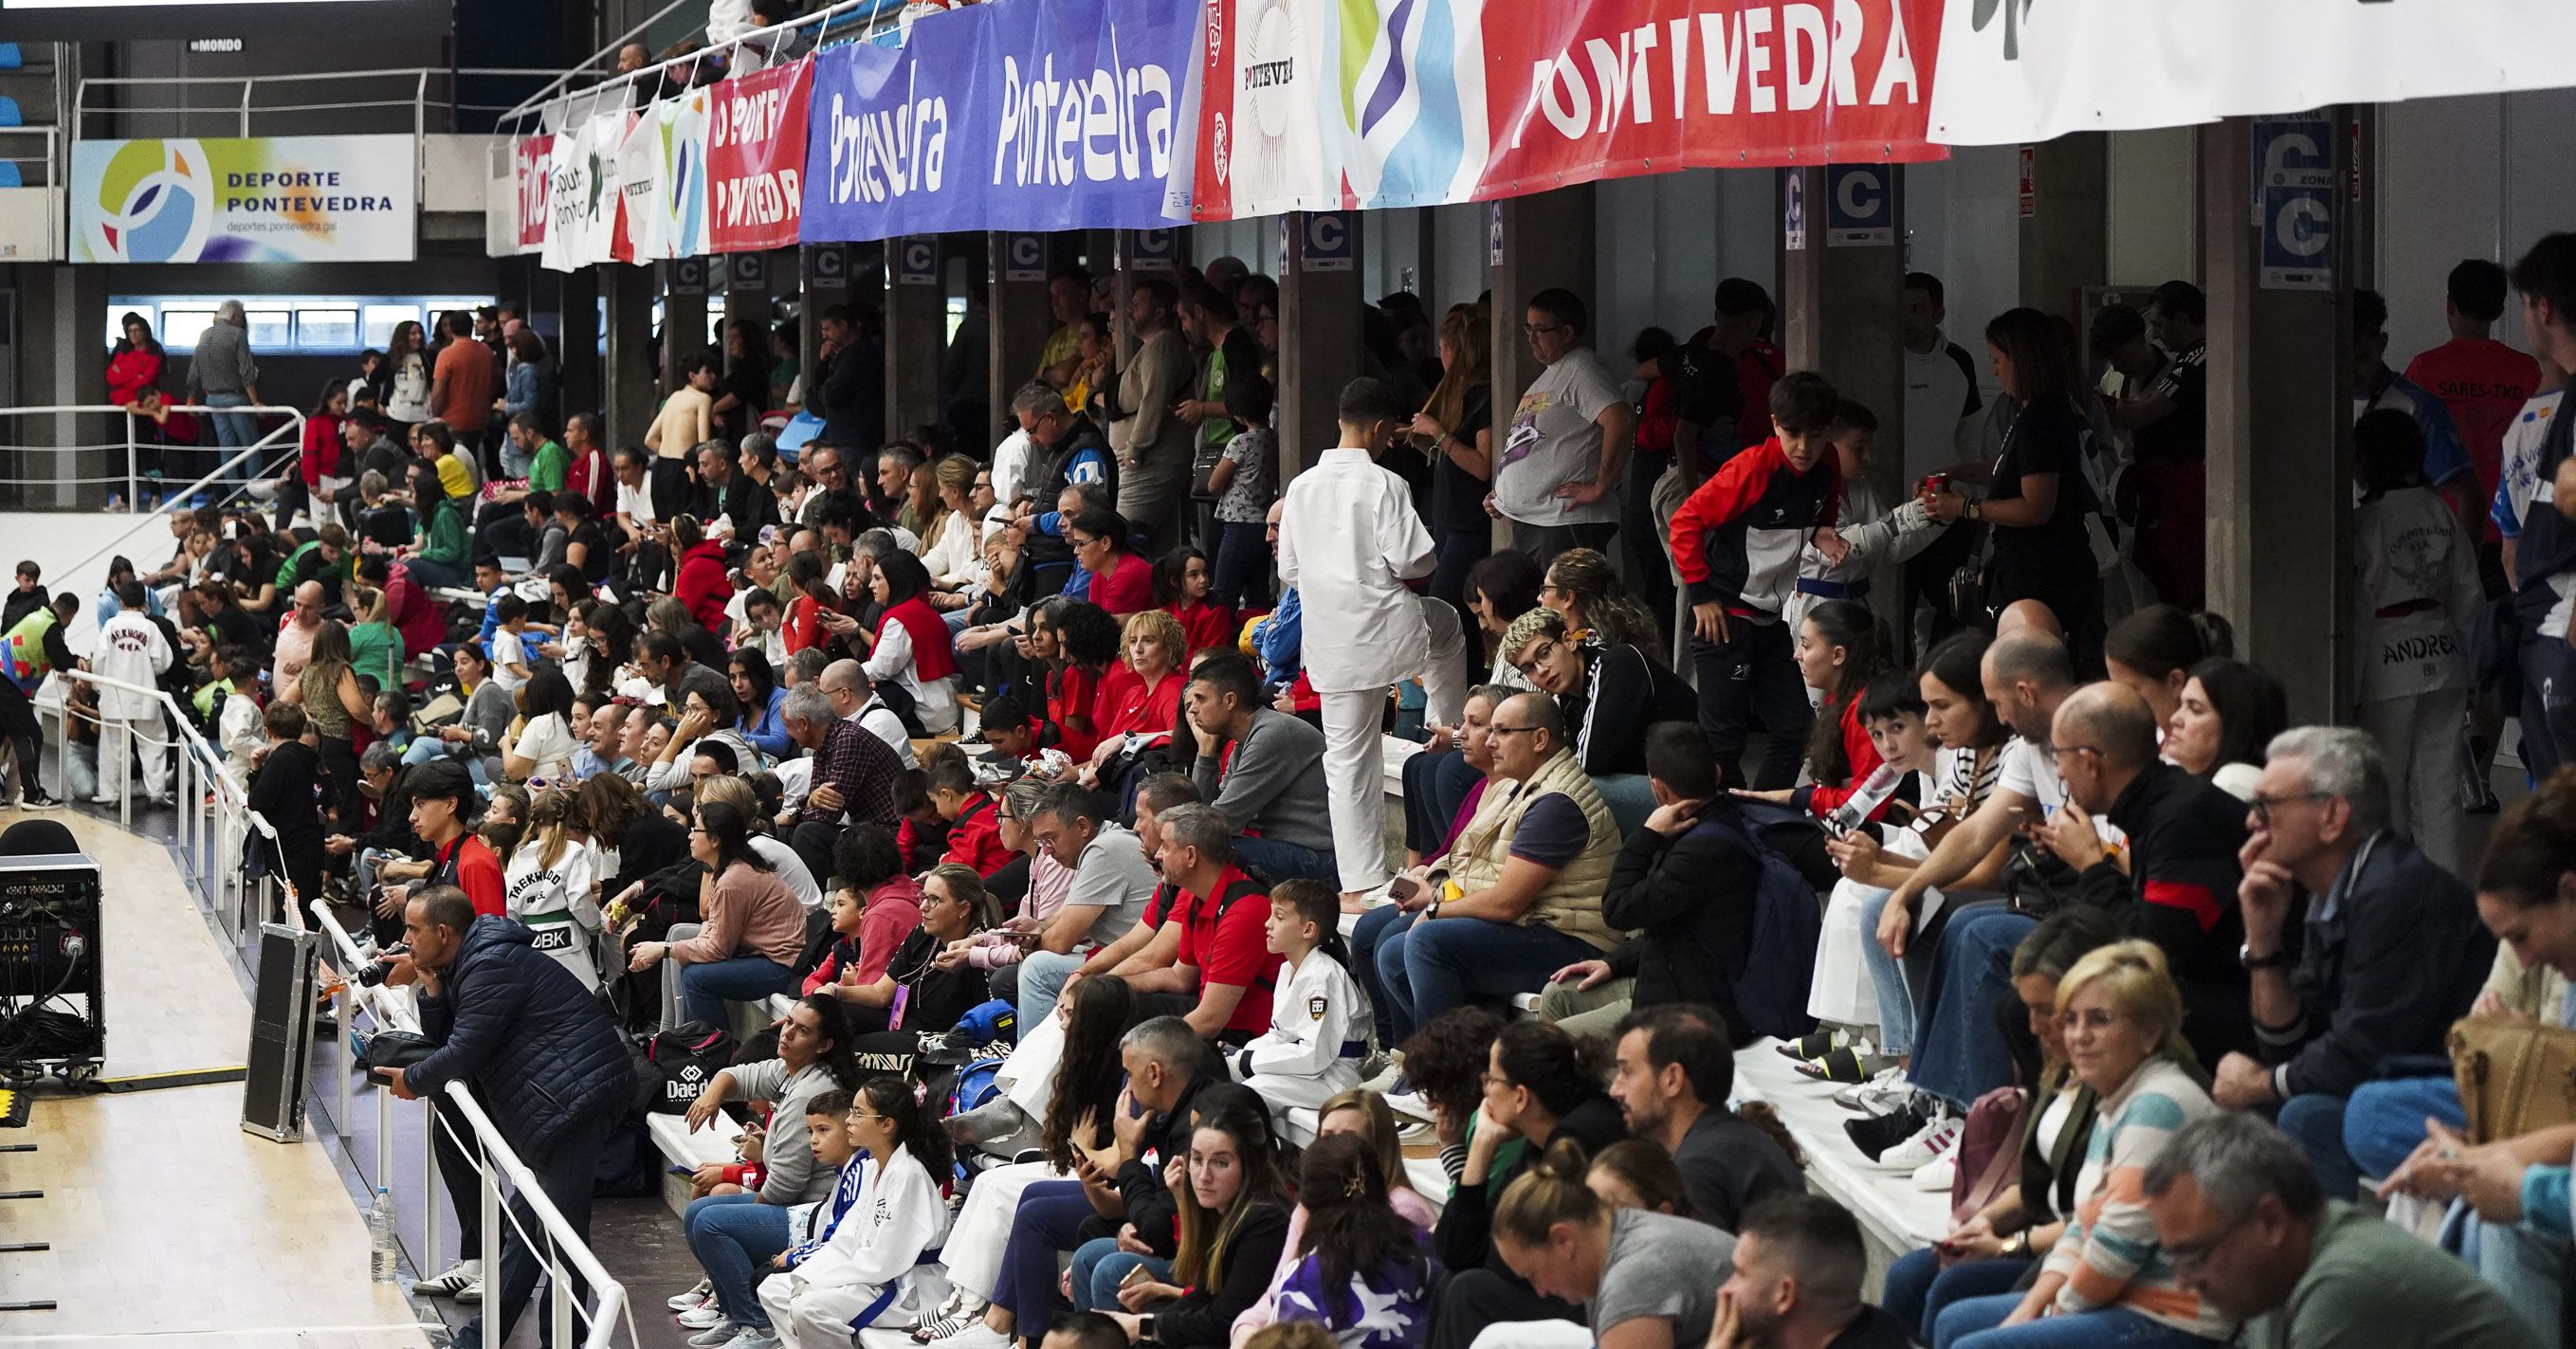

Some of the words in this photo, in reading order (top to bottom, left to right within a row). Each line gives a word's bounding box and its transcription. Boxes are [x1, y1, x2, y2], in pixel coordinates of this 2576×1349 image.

[199, 38, 242, 52] MONDO
[228, 172, 340, 188] DEPORTE
[227, 196, 393, 213] PONTEVEDRA
[1788, 173, 1801, 222] C
[1836, 171, 1882, 219] C
[227, 221, 338, 233] deportes.pontevedra.gal
[1310, 215, 1344, 251] C
[2275, 197, 2330, 257] C
[817, 249, 840, 275] C
[906, 243, 931, 270] C
[1012, 236, 1040, 265] C
[679, 262, 699, 284] C
[738, 255, 758, 278] C
[2438, 381, 2524, 400] SARES-TKD
[508, 869, 561, 900] TAEKWDO
[667, 1078, 709, 1099] Daed
